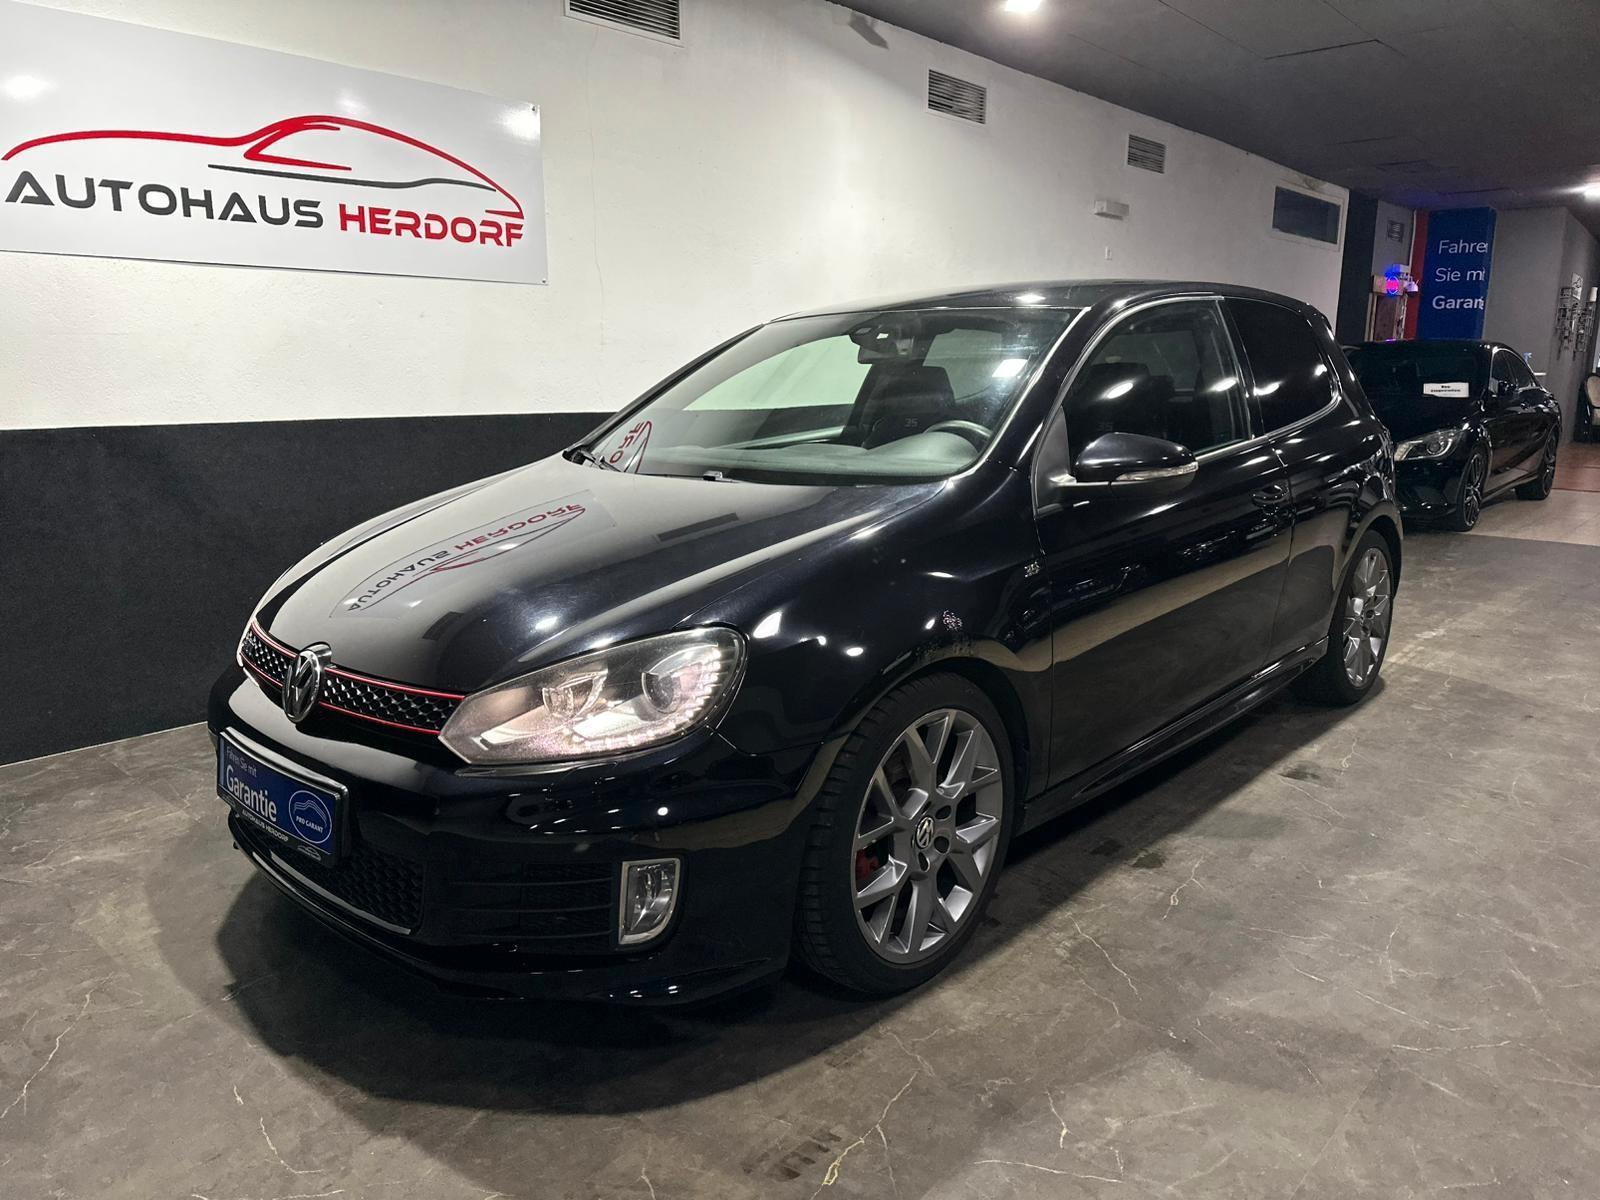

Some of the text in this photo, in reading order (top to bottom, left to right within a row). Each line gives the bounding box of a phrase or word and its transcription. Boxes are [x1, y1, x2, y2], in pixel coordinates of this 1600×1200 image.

[4, 170, 524, 248] AUTOHAUS HERDORF
[1435, 267, 1460, 282] Sie
[226, 764, 277, 822] Garantie
